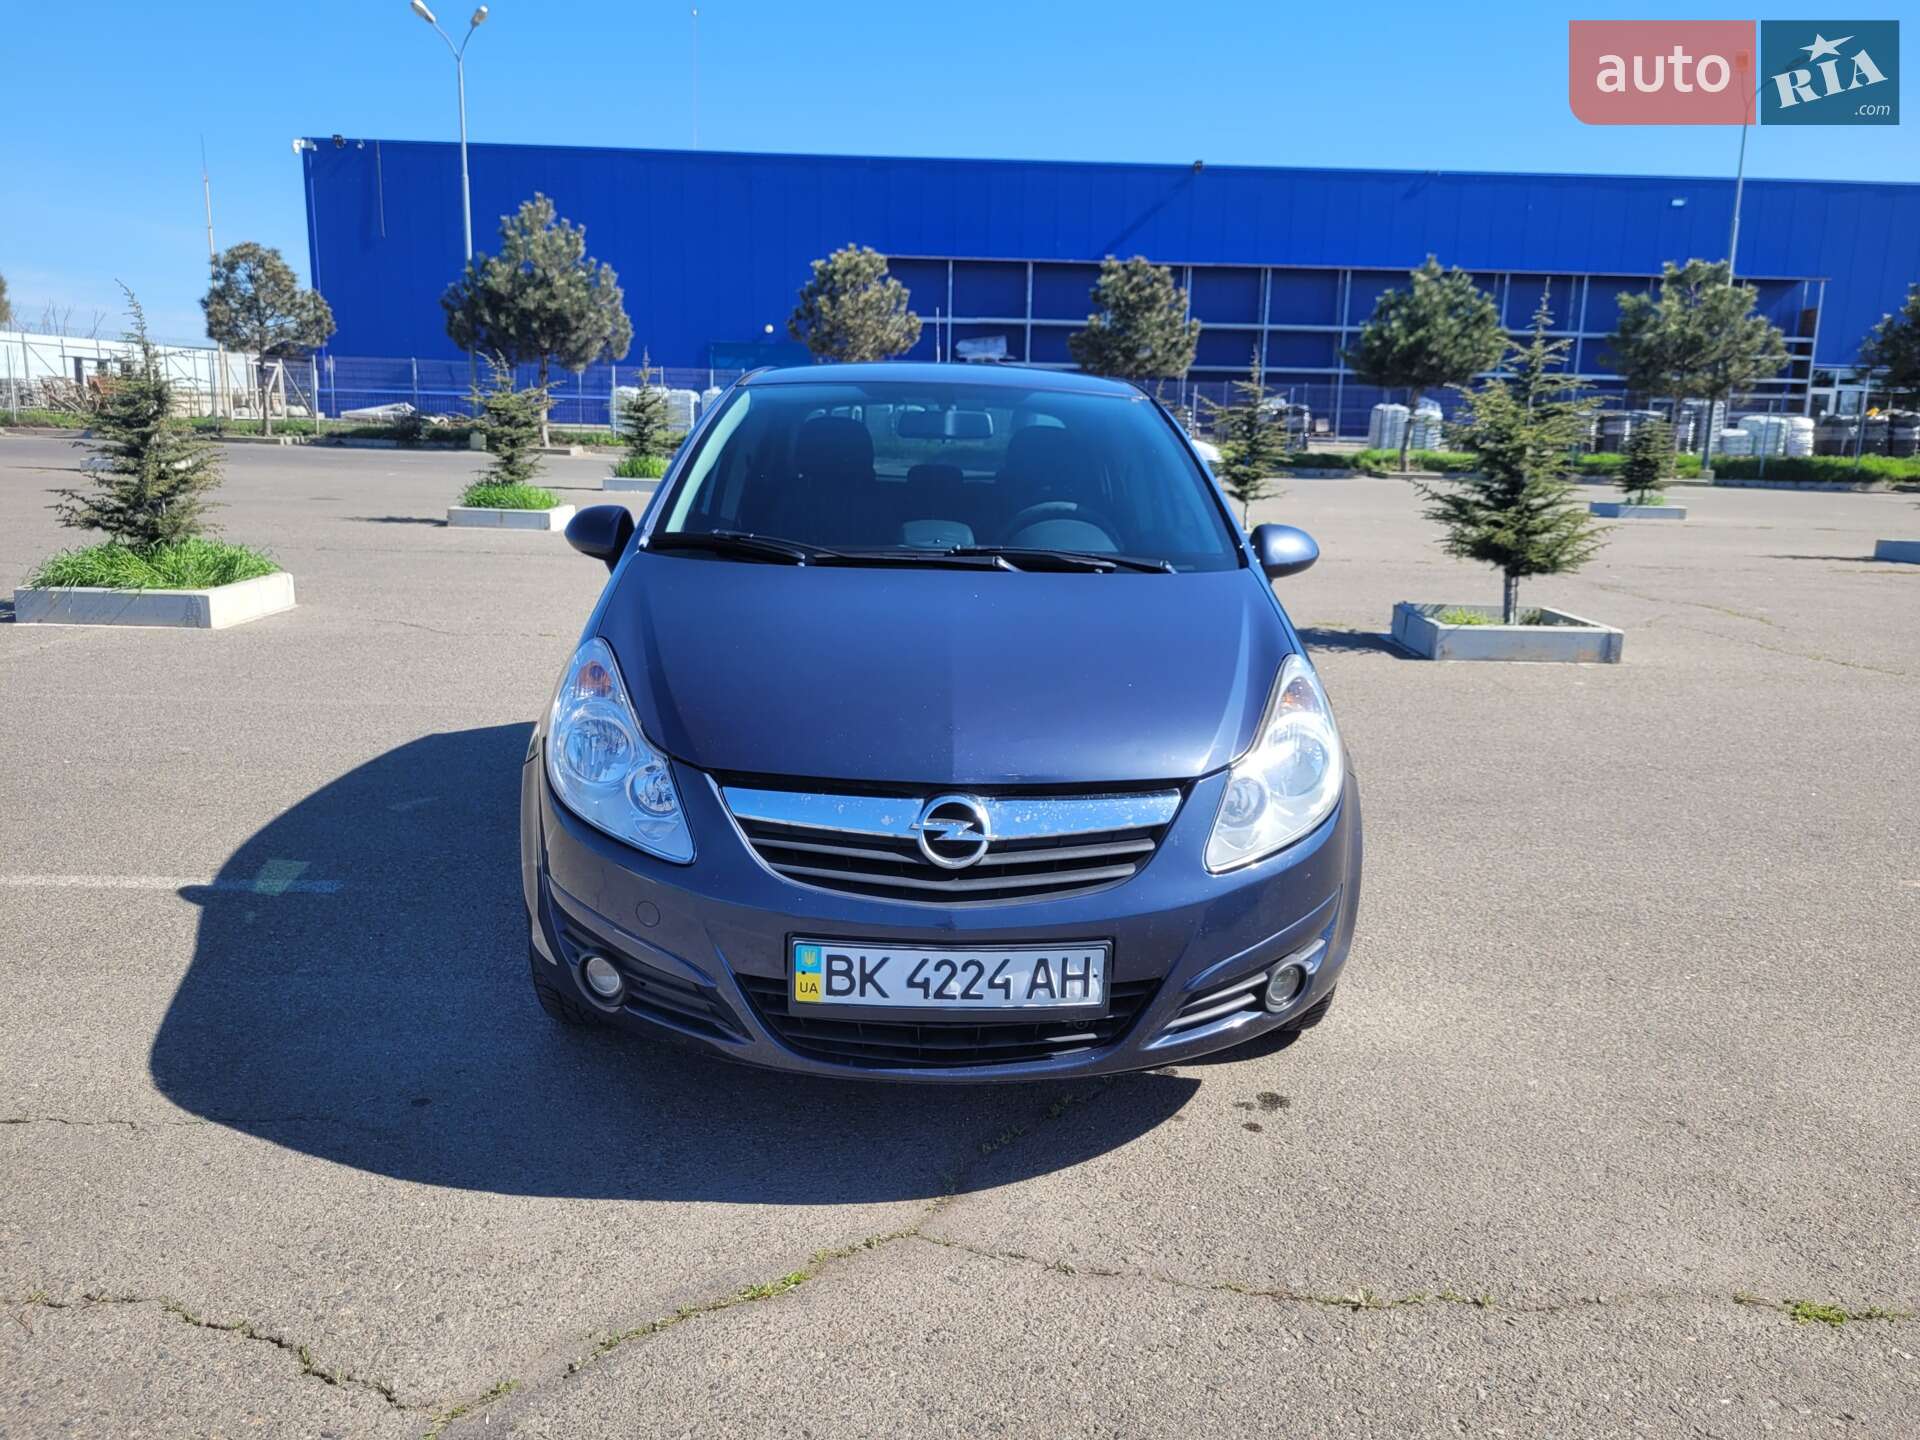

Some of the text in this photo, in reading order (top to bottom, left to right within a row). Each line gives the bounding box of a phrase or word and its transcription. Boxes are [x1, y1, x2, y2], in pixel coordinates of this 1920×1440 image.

[799, 981, 819, 994] UA
[824, 954, 1092, 1001] BK 4224 AH
